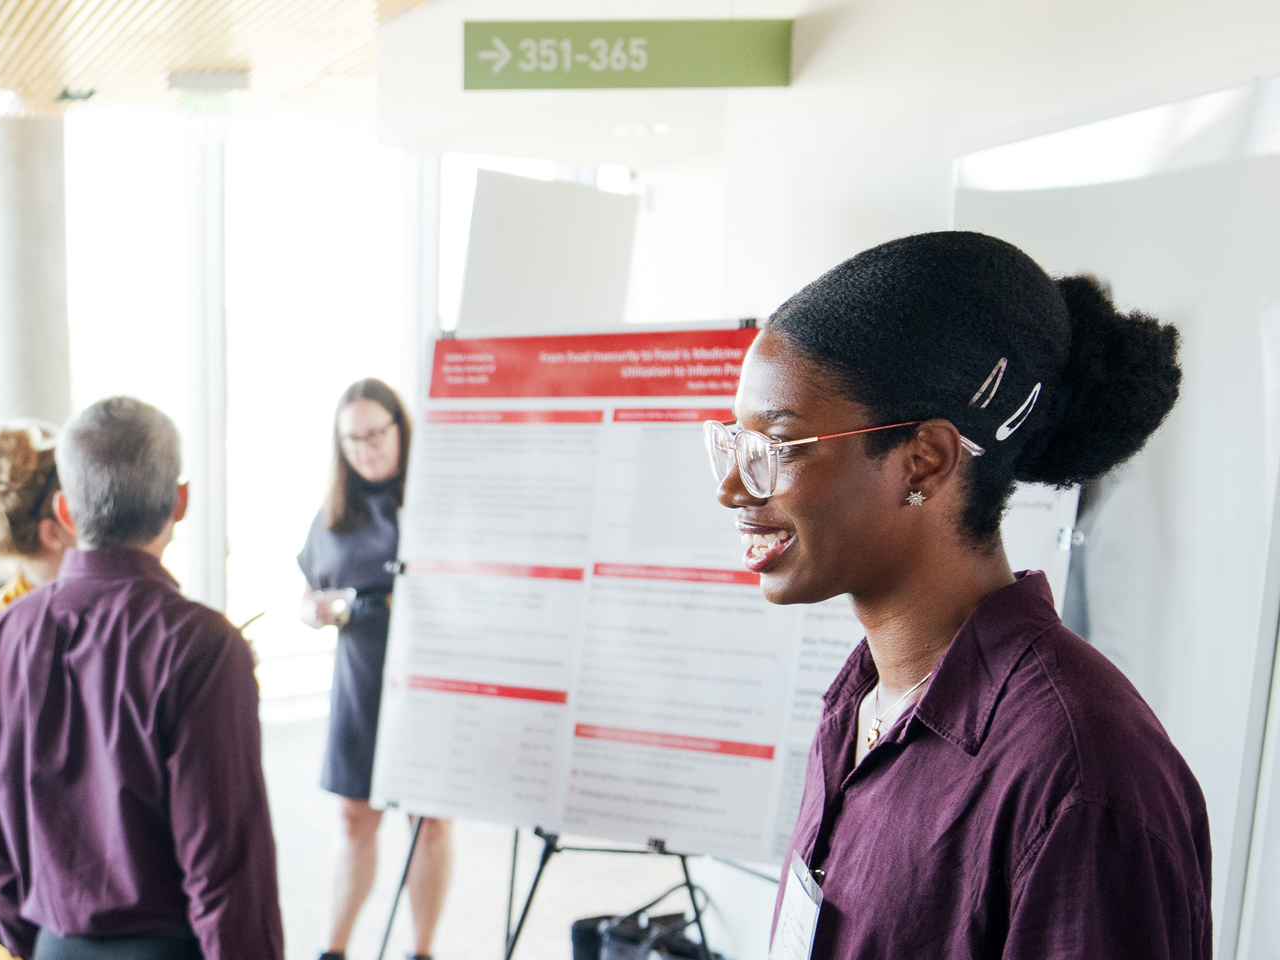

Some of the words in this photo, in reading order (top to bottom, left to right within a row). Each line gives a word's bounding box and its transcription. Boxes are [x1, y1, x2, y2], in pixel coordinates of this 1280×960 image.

[518, 37, 649, 72] 351-365
[594, 348, 640, 363] Insecurity
[641, 348, 654, 361] to
[654, 347, 682, 360] Food
[693, 345, 743, 359] Medicine
[621, 364, 673, 377] Utilization
[674, 364, 686, 376] to
[1013, 500, 1052, 512] ncluding
